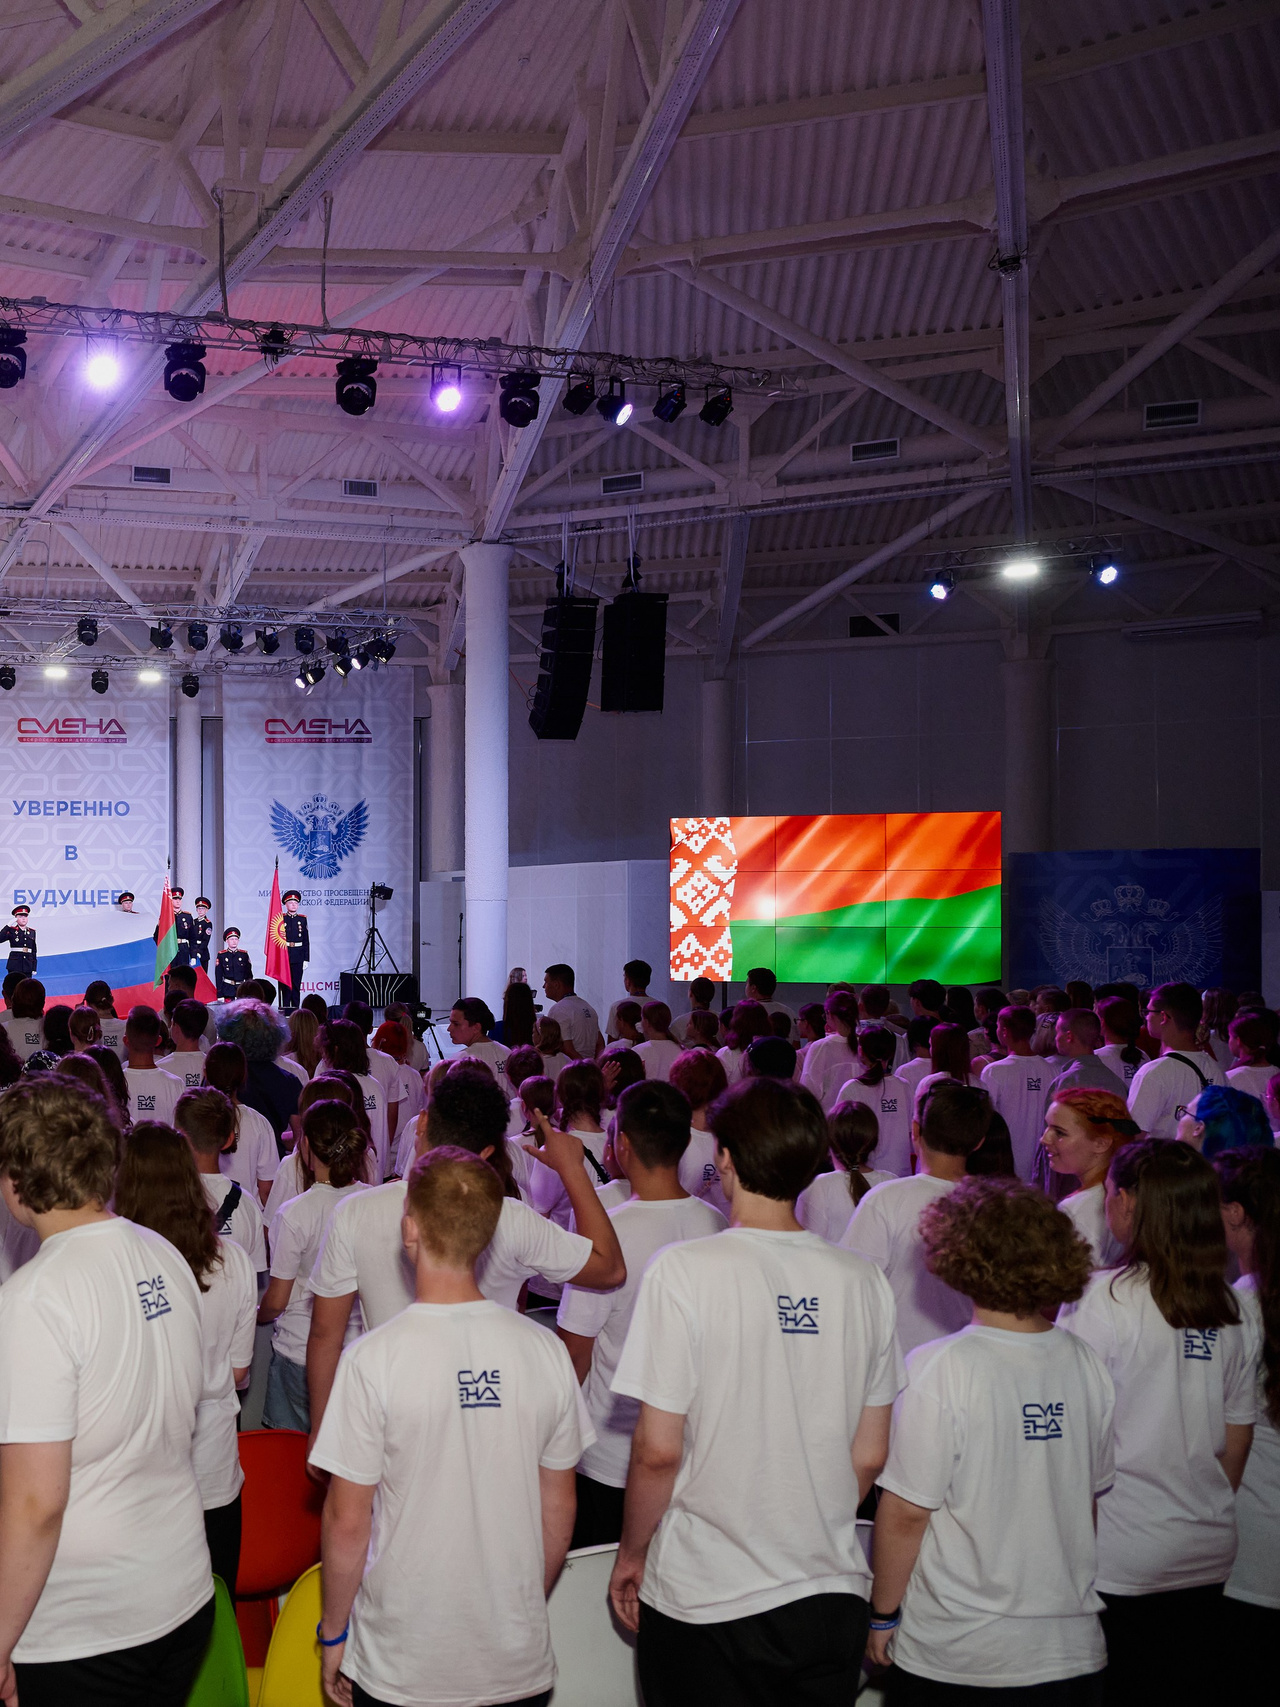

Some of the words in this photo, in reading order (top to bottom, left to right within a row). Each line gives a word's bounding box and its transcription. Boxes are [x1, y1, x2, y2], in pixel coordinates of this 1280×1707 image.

[17, 718, 127, 734] СМЕНА
[265, 719, 372, 734] СМЕНА
[12, 800, 130, 816] УВЕРЕННО
[65, 845, 78, 861] В
[13, 889, 129, 908] БУДУЩЕЕ
[324, 889, 371, 897] ПРОСВЕЩЕН
[324, 898, 370, 906] ФЕДЕРАЦИИ
